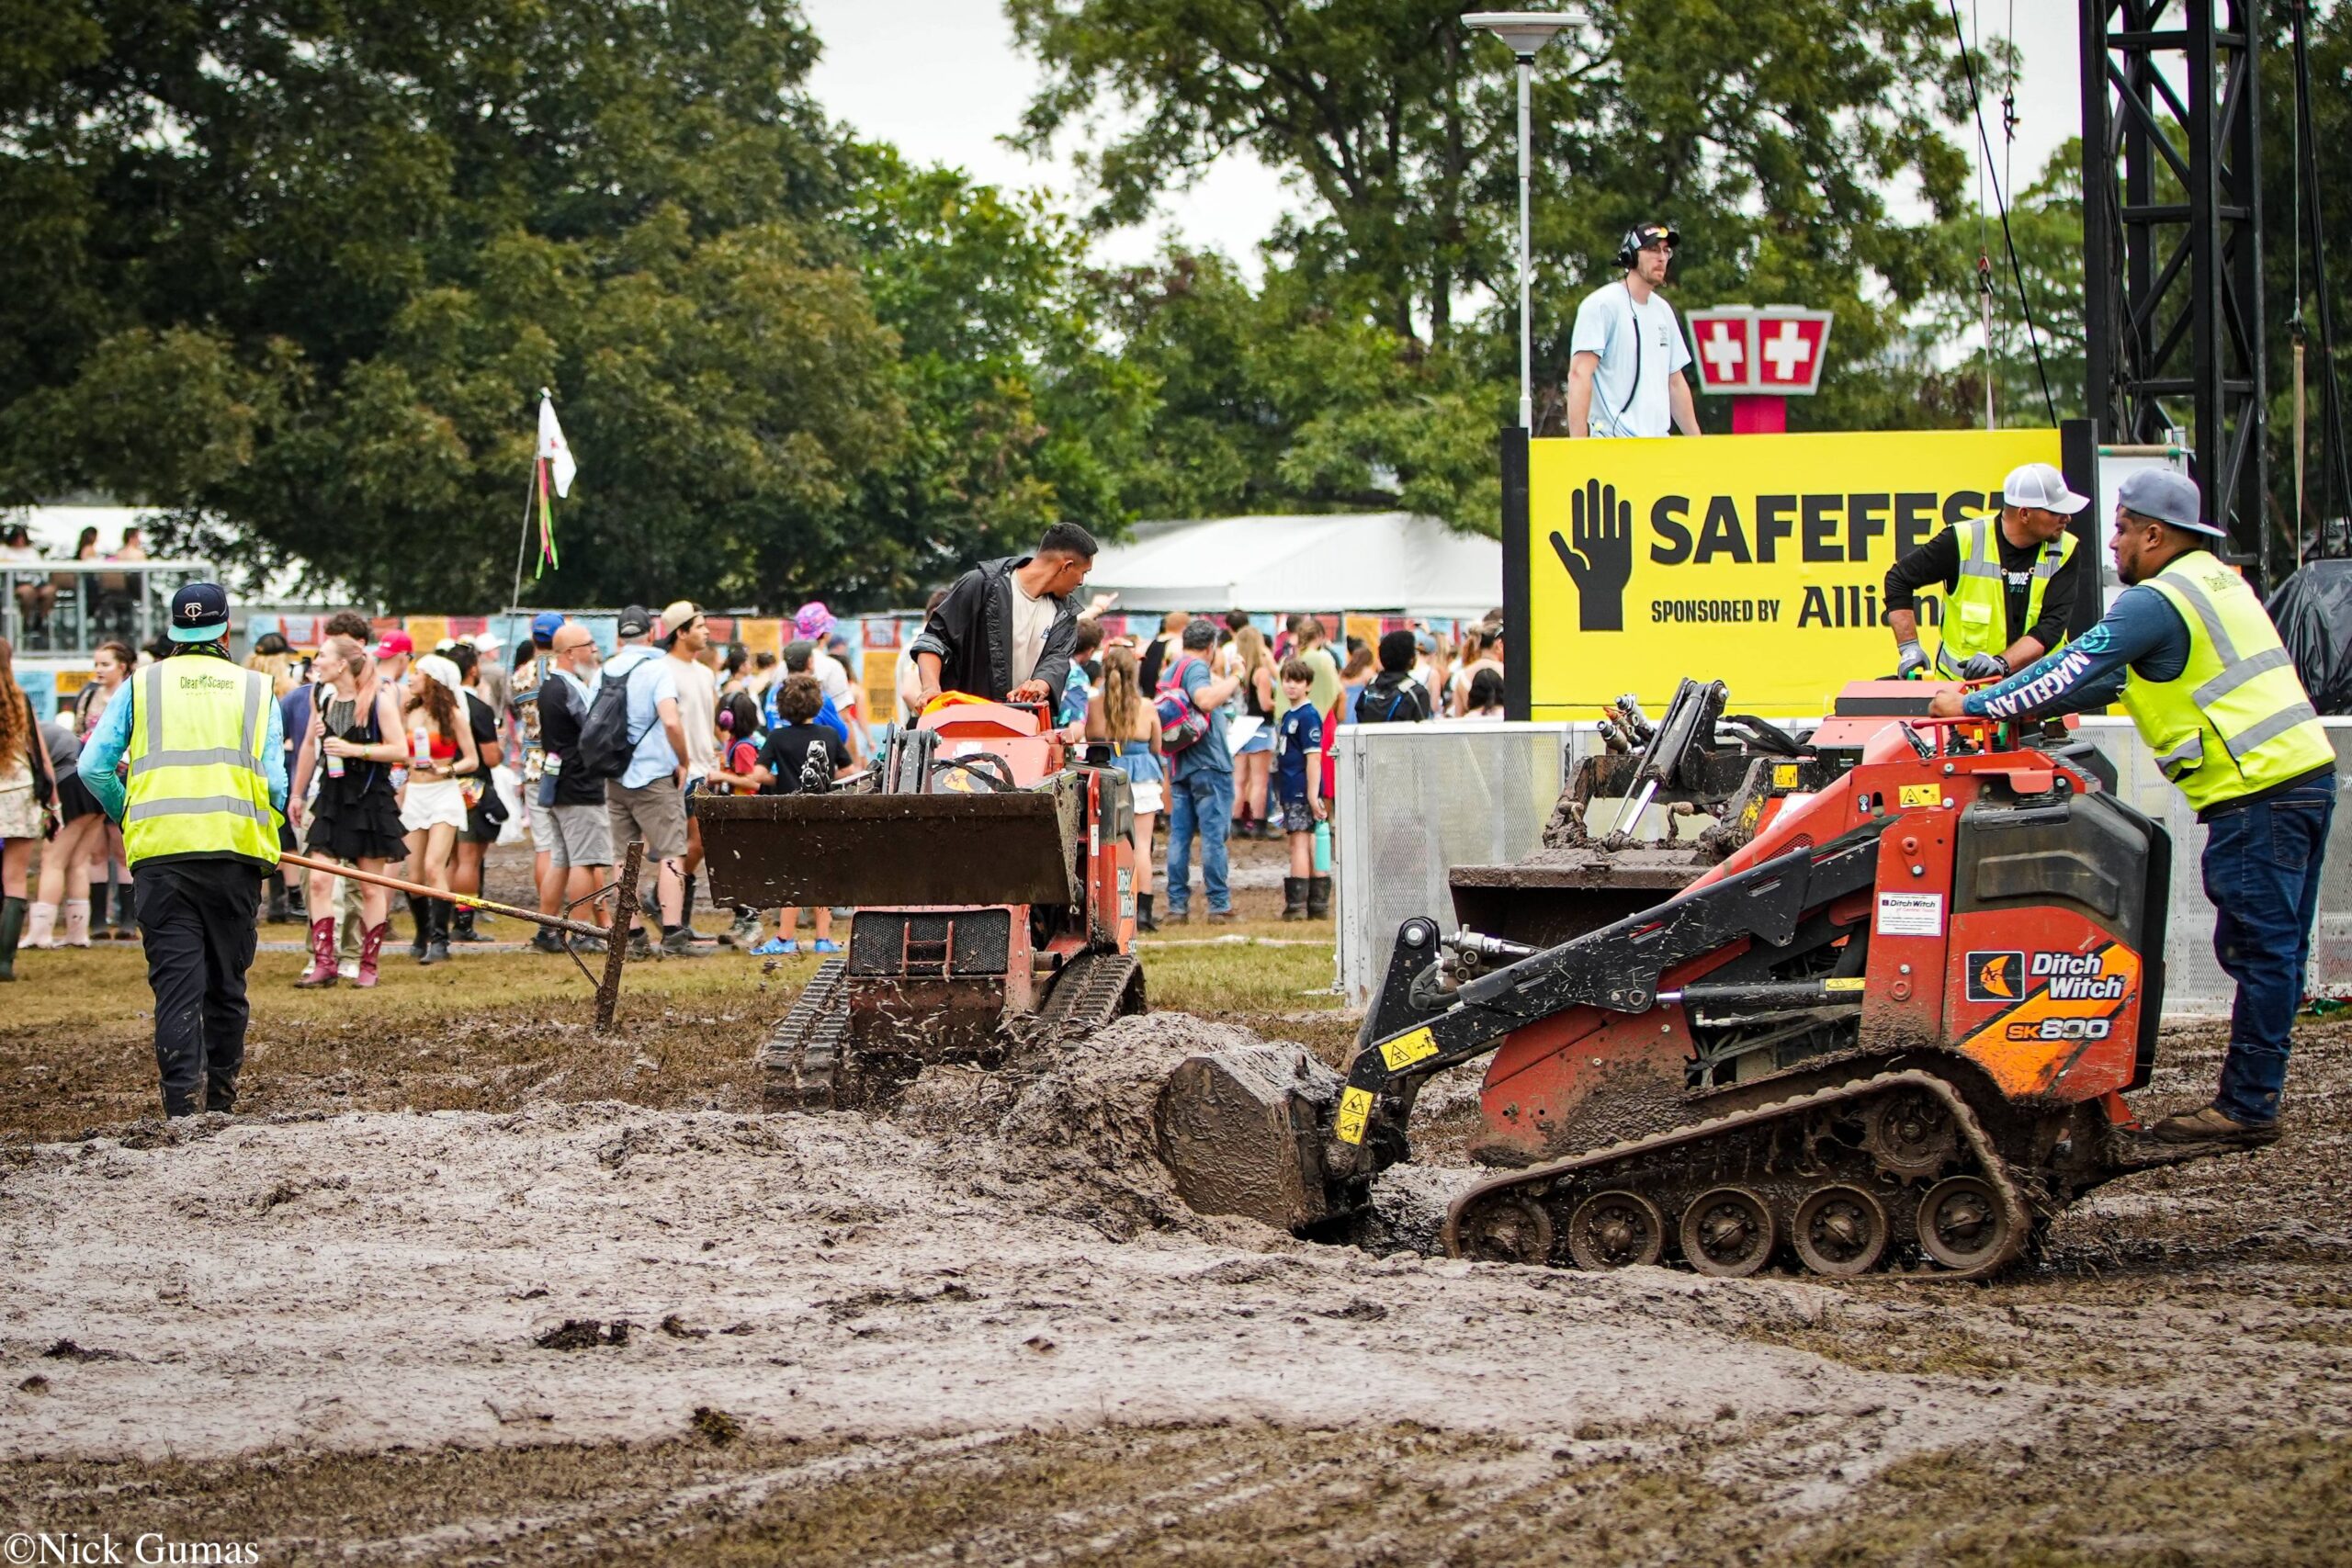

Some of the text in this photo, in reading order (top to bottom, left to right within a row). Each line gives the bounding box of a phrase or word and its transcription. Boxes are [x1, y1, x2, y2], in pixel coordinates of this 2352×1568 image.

[1650, 491, 2005, 566] SAFEFES
[1651, 584, 1940, 628] SPONSORED BY Allin
[180, 676, 234, 690] Clear Scapes
[1984, 649, 2091, 718] MAGELLAN
[2030, 953, 2102, 976] Ditch
[2049, 976, 2123, 998] Witch
[2007, 1017, 2110, 1042] SK800
